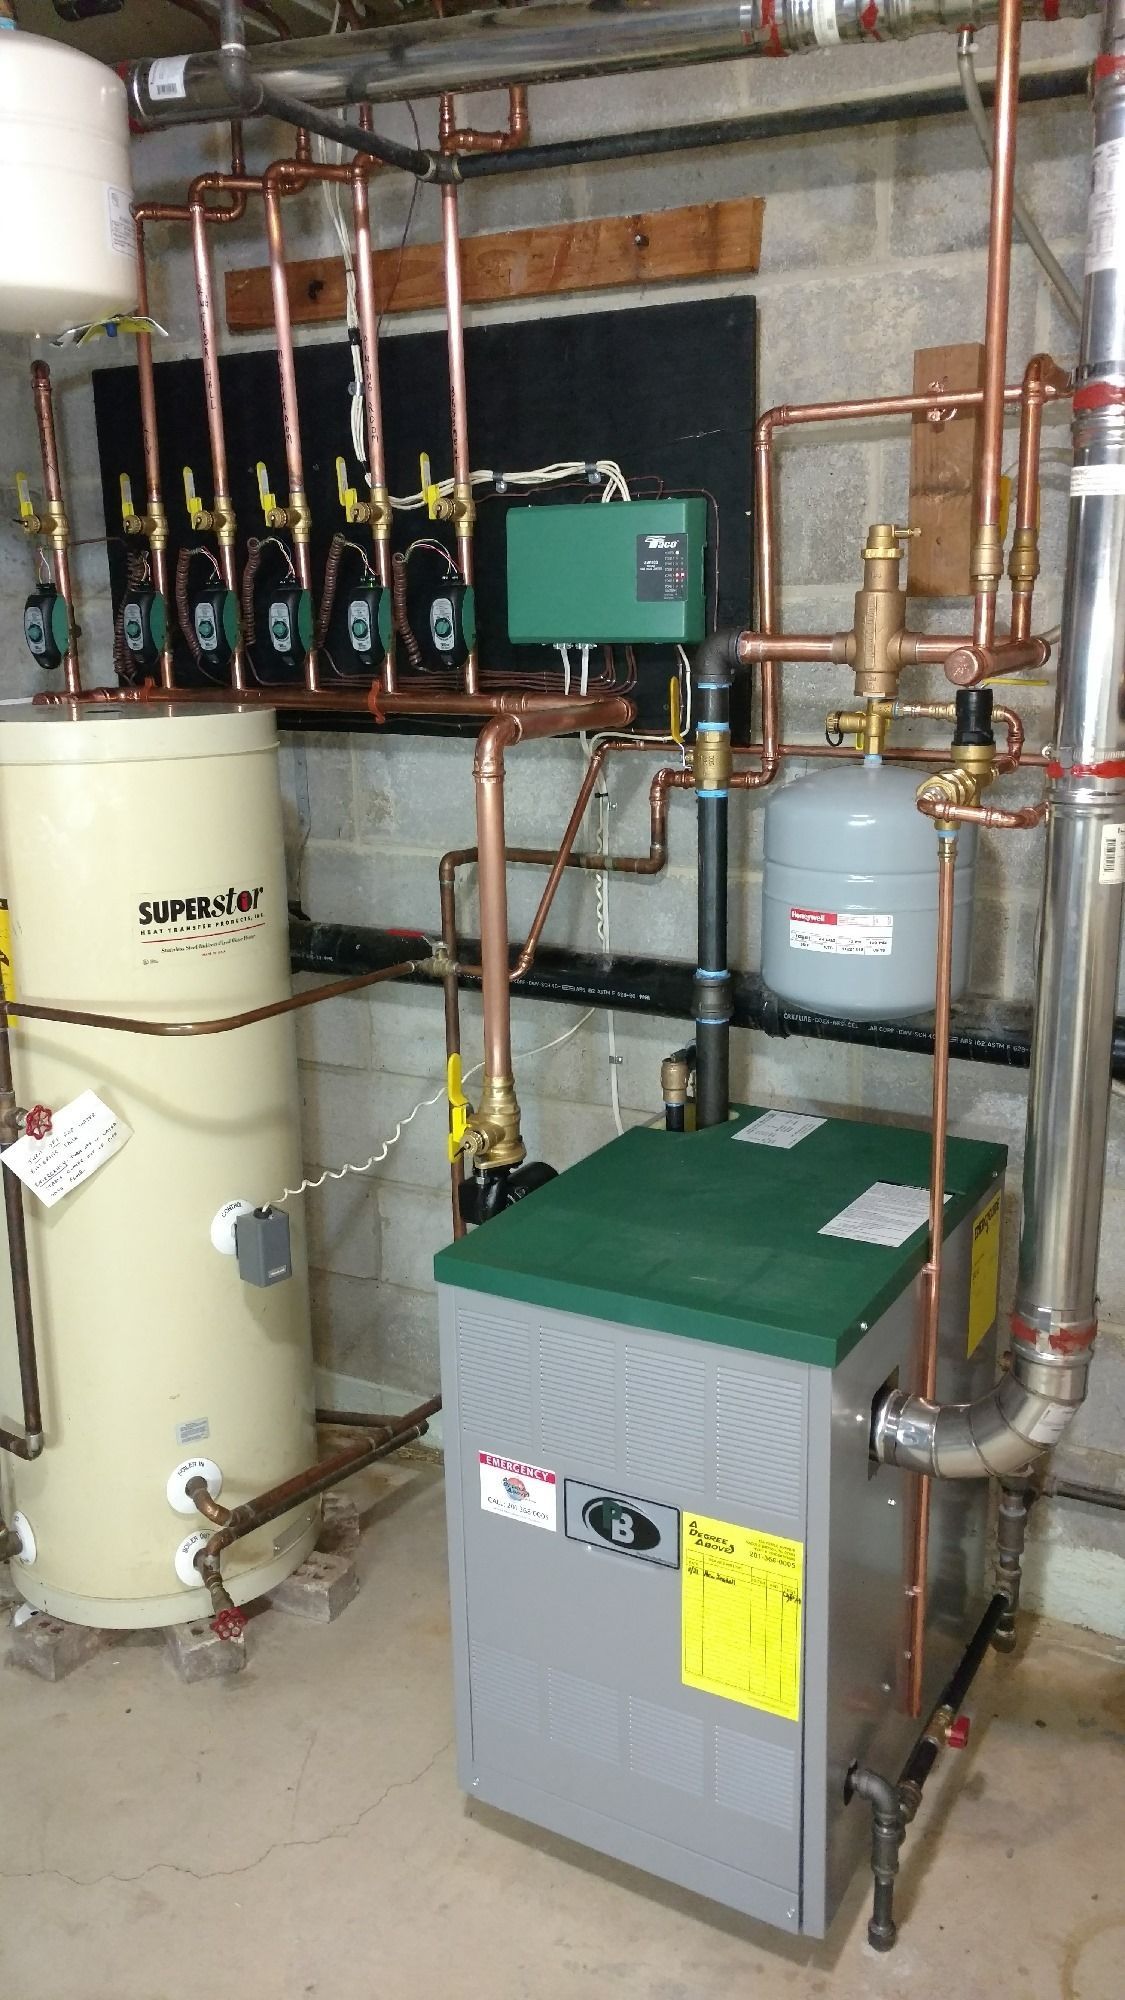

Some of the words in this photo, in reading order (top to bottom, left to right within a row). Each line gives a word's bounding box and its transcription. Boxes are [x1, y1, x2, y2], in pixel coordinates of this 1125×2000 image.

[644, 535, 679, 549] Taco
[791, 910, 826, 922] Honeywell
[140, 927, 164, 936] HEAT
[168, 923, 213, 934] TRANSFER
[987, 1041, 1005, 1050] ASTM
[198, 1460, 205, 1468] IN
[486, 1453, 550, 1483] EMERGENCY
[688, 1520, 698, 1529] A
[688, 1528, 729, 1546] DEGREE
[182, 1534, 199, 1554] BOILER
